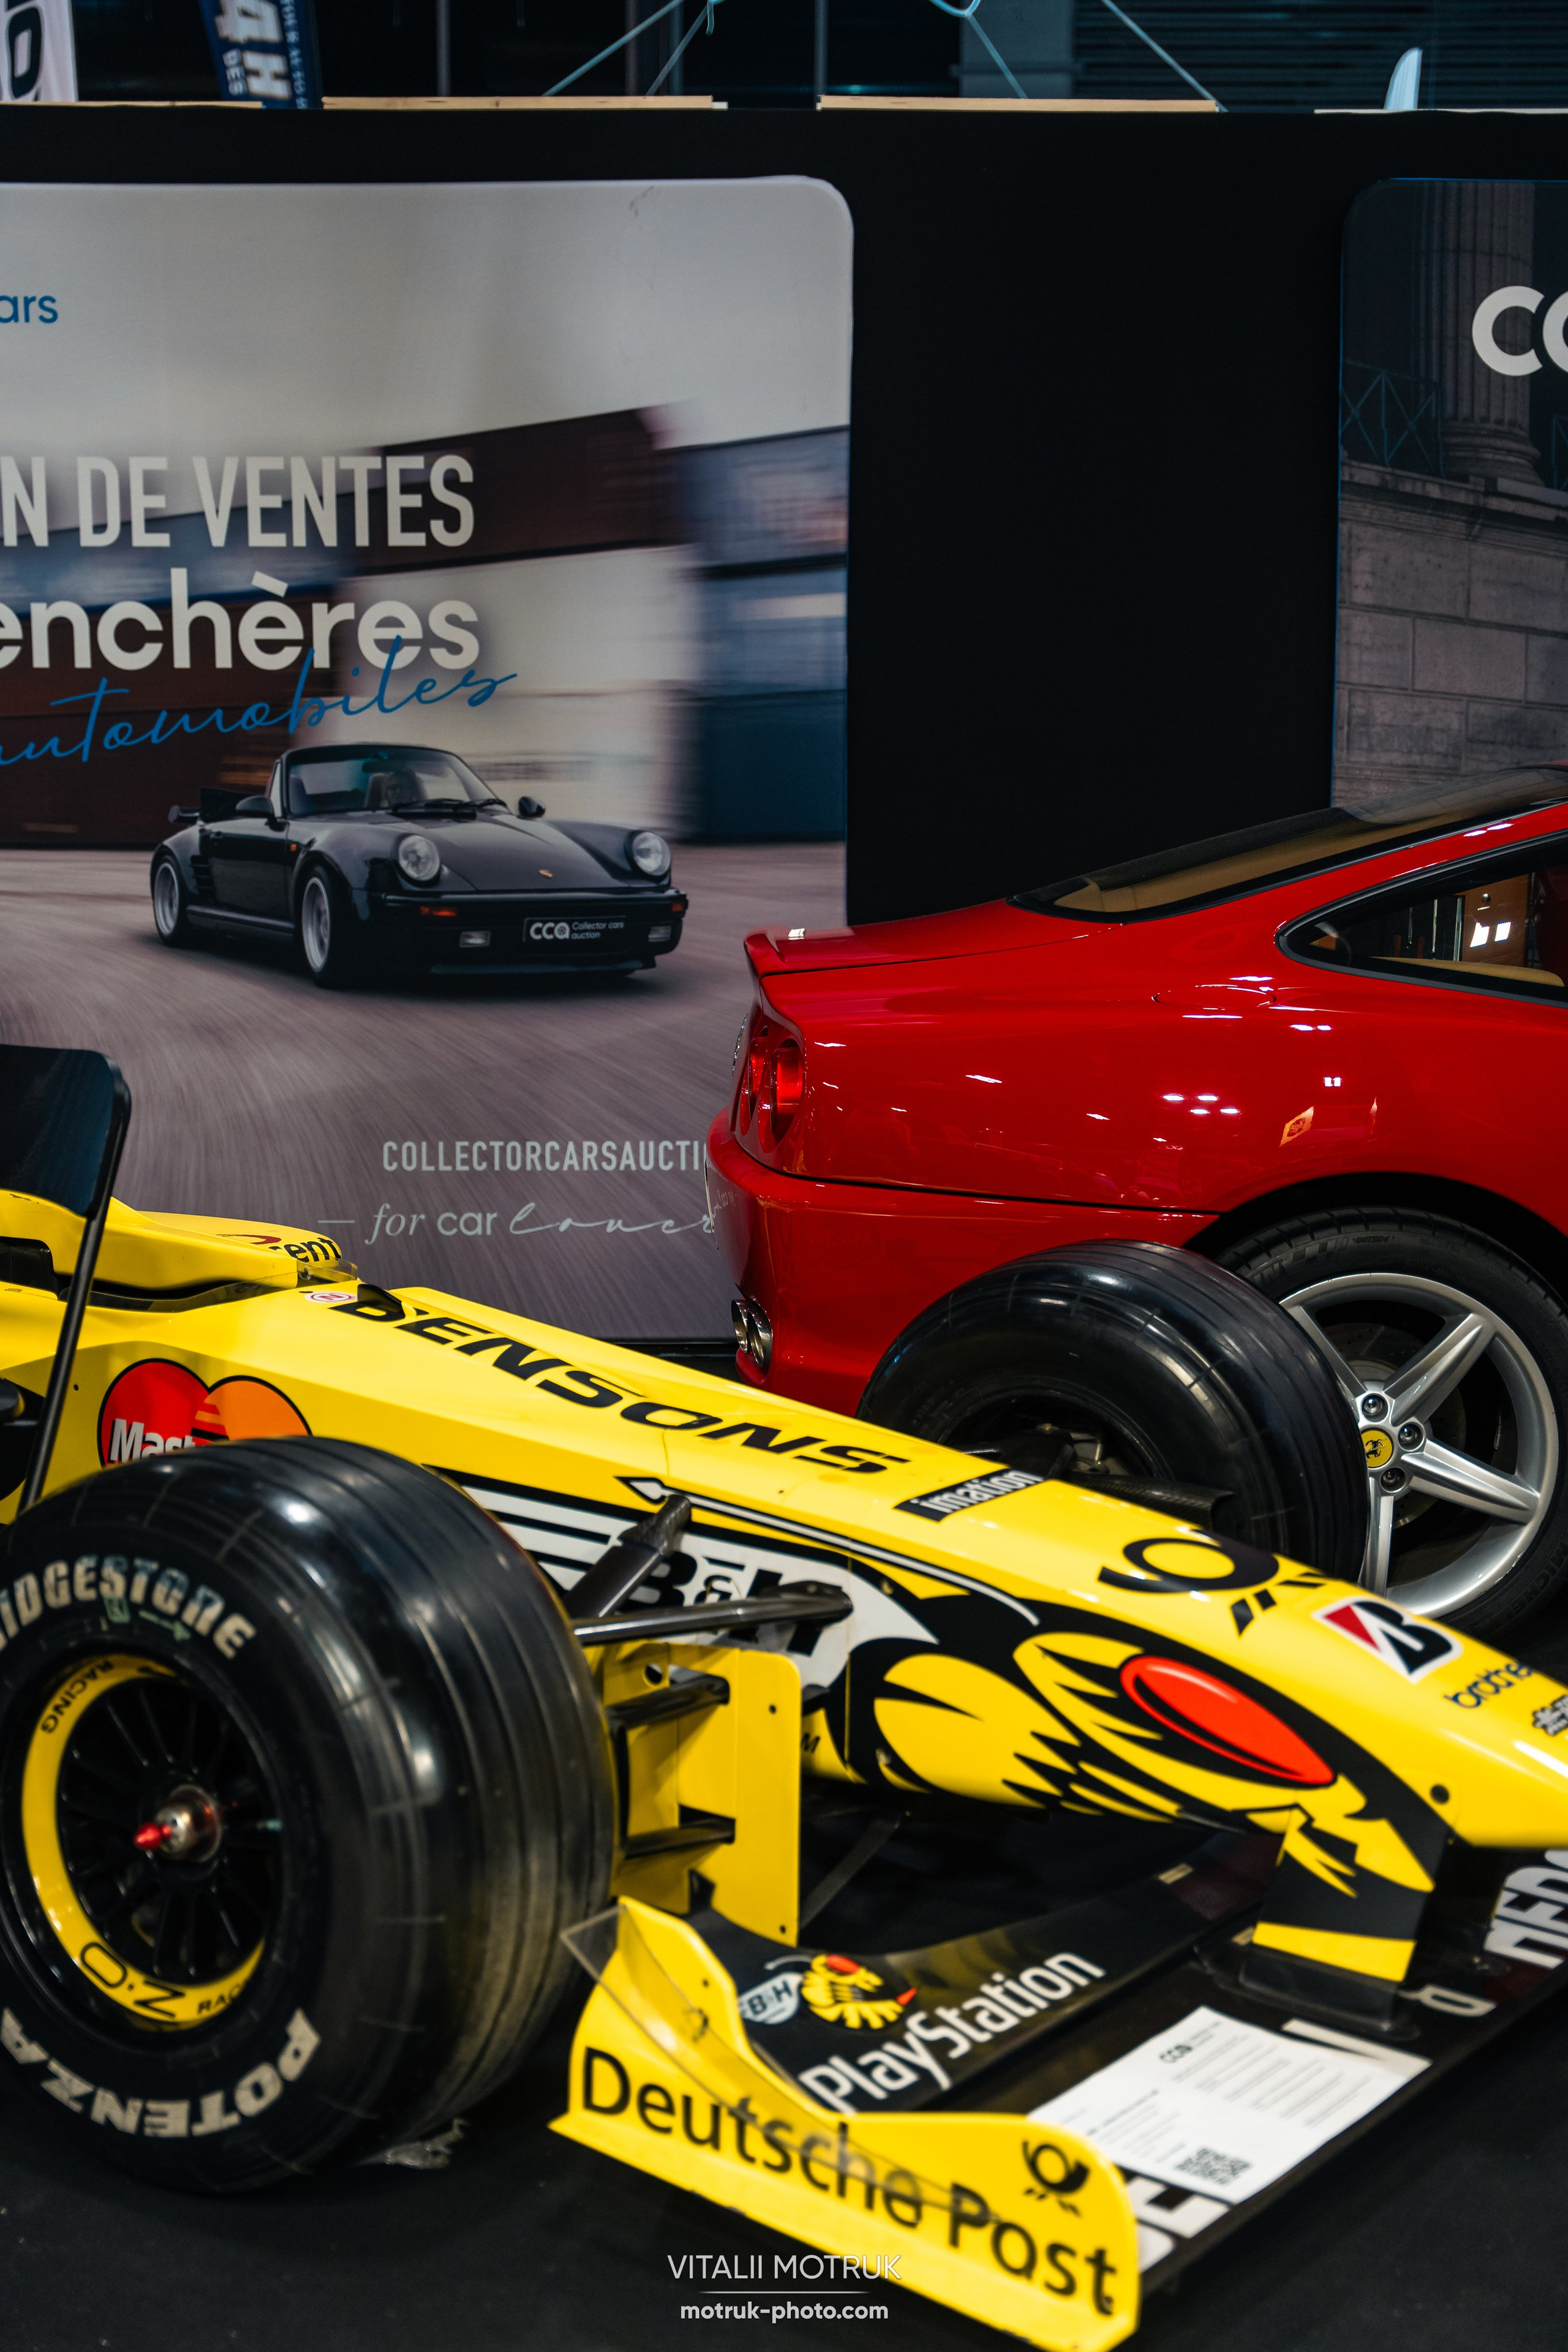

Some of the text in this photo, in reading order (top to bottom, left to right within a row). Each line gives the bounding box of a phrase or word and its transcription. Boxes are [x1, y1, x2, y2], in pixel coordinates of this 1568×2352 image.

[77, 456, 171, 547] DE
[192, 454, 476, 548] VENTES
[571, 921, 606, 930] Collector
[571, 931, 600, 940] auction
[383, 1140, 707, 1171] COLLECTORCARSAUCTI
[365, 1203, 425, 1245] for
[437, 1210, 497, 1236] car
[910, 1469, 1044, 1513] imation
[799, 1951, 1106, 2114] PlayStation
[0, 2007, 320, 2138] POTENZA
[582, 2046, 924, 2229] Deutsche
[948, 2180, 1118, 2316] Post
